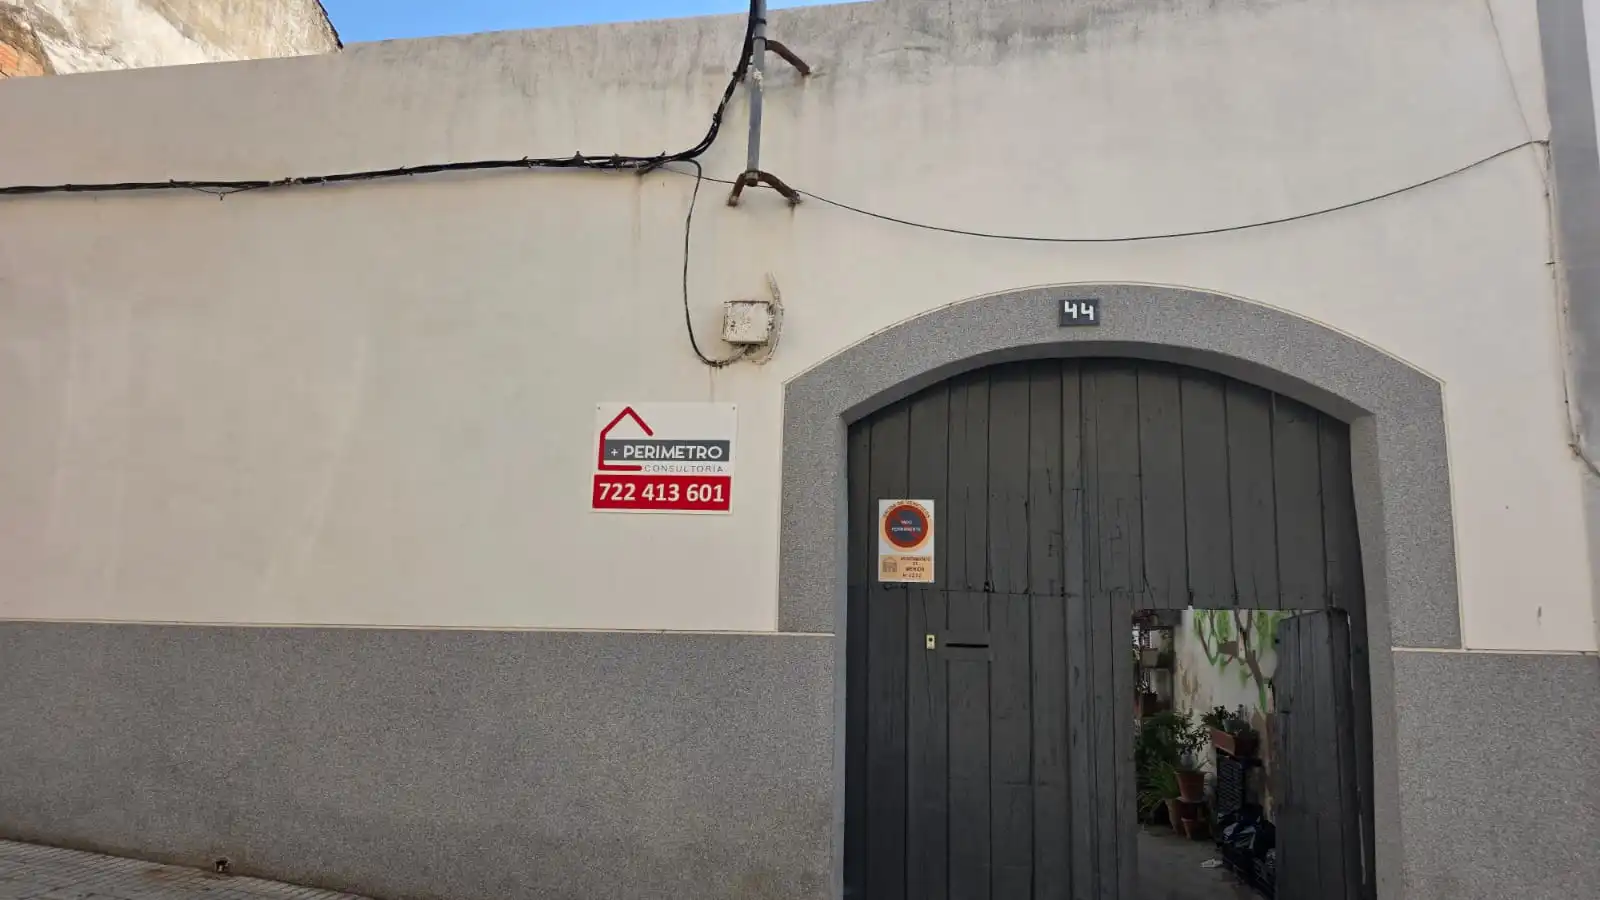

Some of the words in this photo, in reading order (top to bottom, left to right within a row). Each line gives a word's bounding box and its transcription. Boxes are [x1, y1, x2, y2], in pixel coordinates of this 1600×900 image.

[1064, 300, 1094, 321] 44
[623, 445, 723, 459] PERIMETRO
[599, 483, 636, 501] 722
[641, 483, 680, 502] 413
[686, 484, 724, 502] 601
